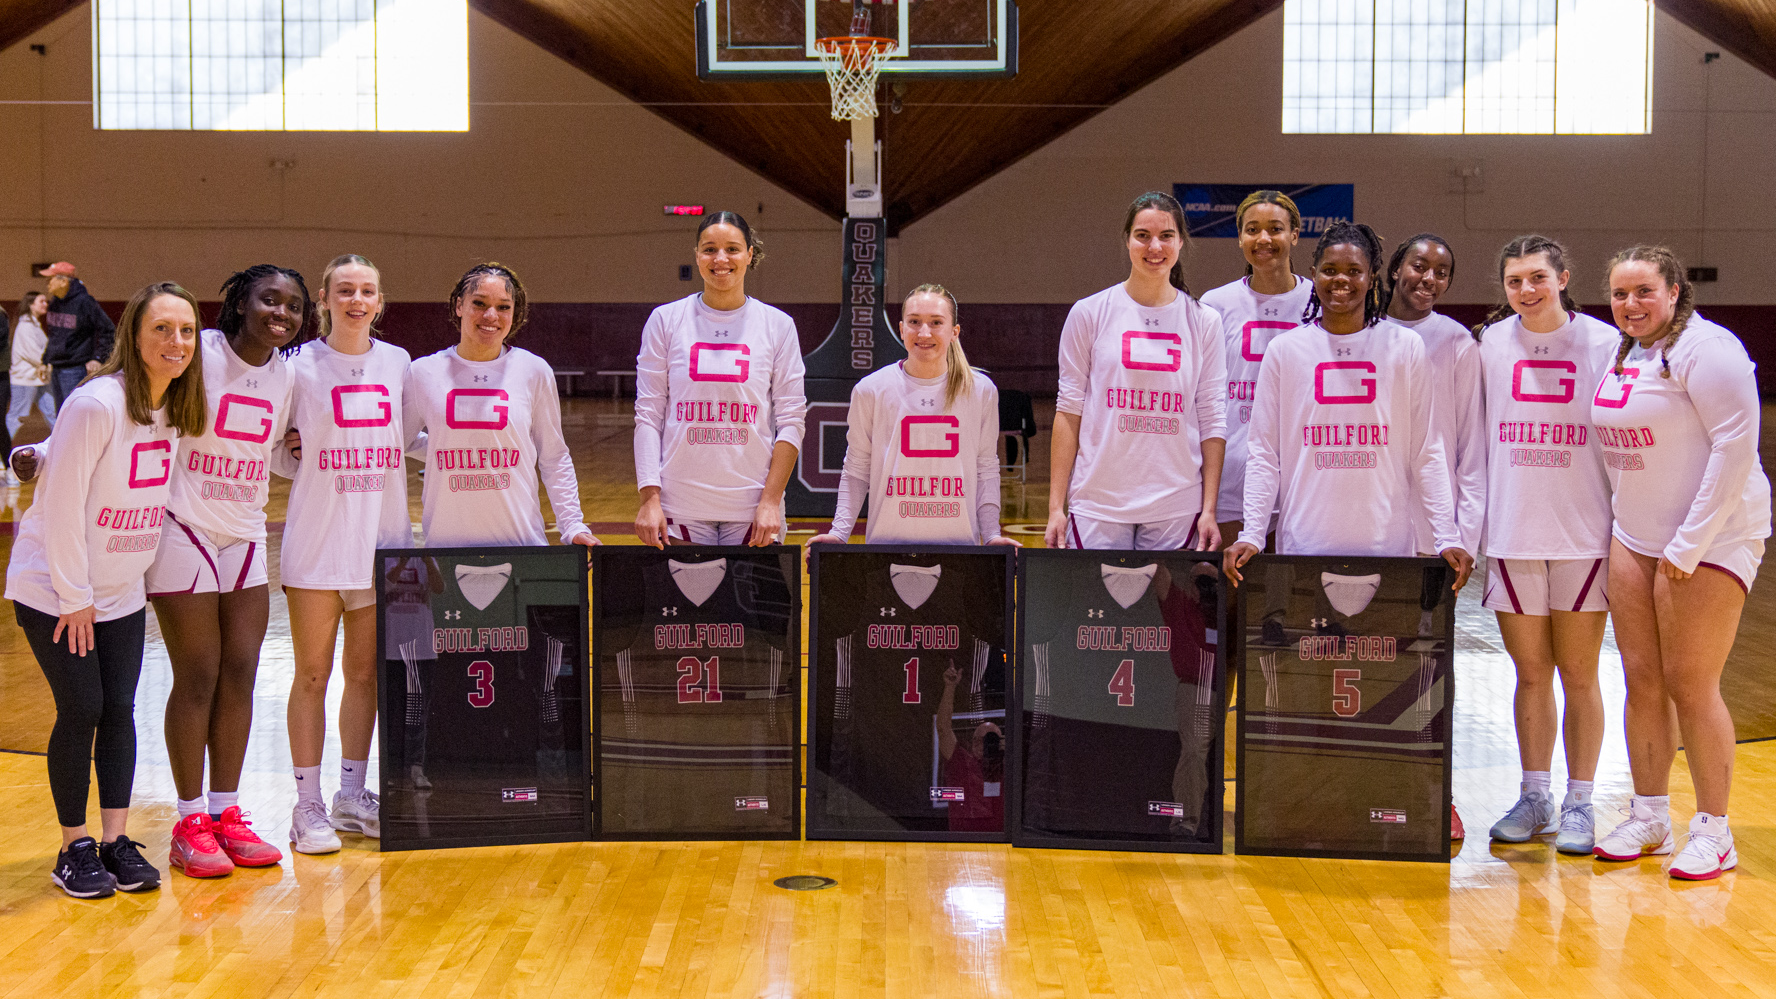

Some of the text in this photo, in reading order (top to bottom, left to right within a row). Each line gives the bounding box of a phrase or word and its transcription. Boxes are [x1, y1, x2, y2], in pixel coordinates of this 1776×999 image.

[1185, 202, 1237, 212] NCAA.com
[851, 222, 876, 370] QUAKERS
[688, 341, 751, 383] G
[1121, 330, 1182, 373] G
[1314, 361, 1377, 405] G
[1511, 359, 1577, 404] G
[1593, 366, 1641, 409] G
[330, 383, 392, 428] G
[445, 388, 509, 430] G
[1105, 387, 1186, 415] GUILFOR
[213, 393, 274, 444] G
[1117, 414, 1180, 436] QUAKERS
[686, 426, 749, 446] QUAKERS
[900, 414, 960, 458] G
[1498, 421, 1589, 447] GUILFORD
[128, 439, 172, 489] G
[187, 448, 270, 482] GUILFOR
[318, 446, 402, 472] GUILFORD
[1314, 450, 1377, 471] QUAKERS
[1509, 448, 1572, 468] QUAKERS
[201, 480, 259, 502] QUAKERS
[335, 473, 386, 494] QUAKER
[449, 472, 511, 493] QUAKERS
[885, 474, 966, 499] GUILFOR
[95, 504, 166, 531] GUILFOR
[898, 500, 961, 519] QUAKERS
[106, 532, 161, 553] QUAKERS
[432, 625, 529, 654] GUILFORD
[654, 622, 745, 650] GUILFORD
[867, 623, 960, 650] GUILFORD
[1076, 624, 1172, 652] GUILFORD
[1299, 635, 1397, 662] GUILFORD
[467, 660, 495, 709] 3
[676, 655, 722, 704] 21
[902, 657, 921, 704] 1
[1107, 659, 1136, 707] 4
[1332, 668, 1361, 717] 5
